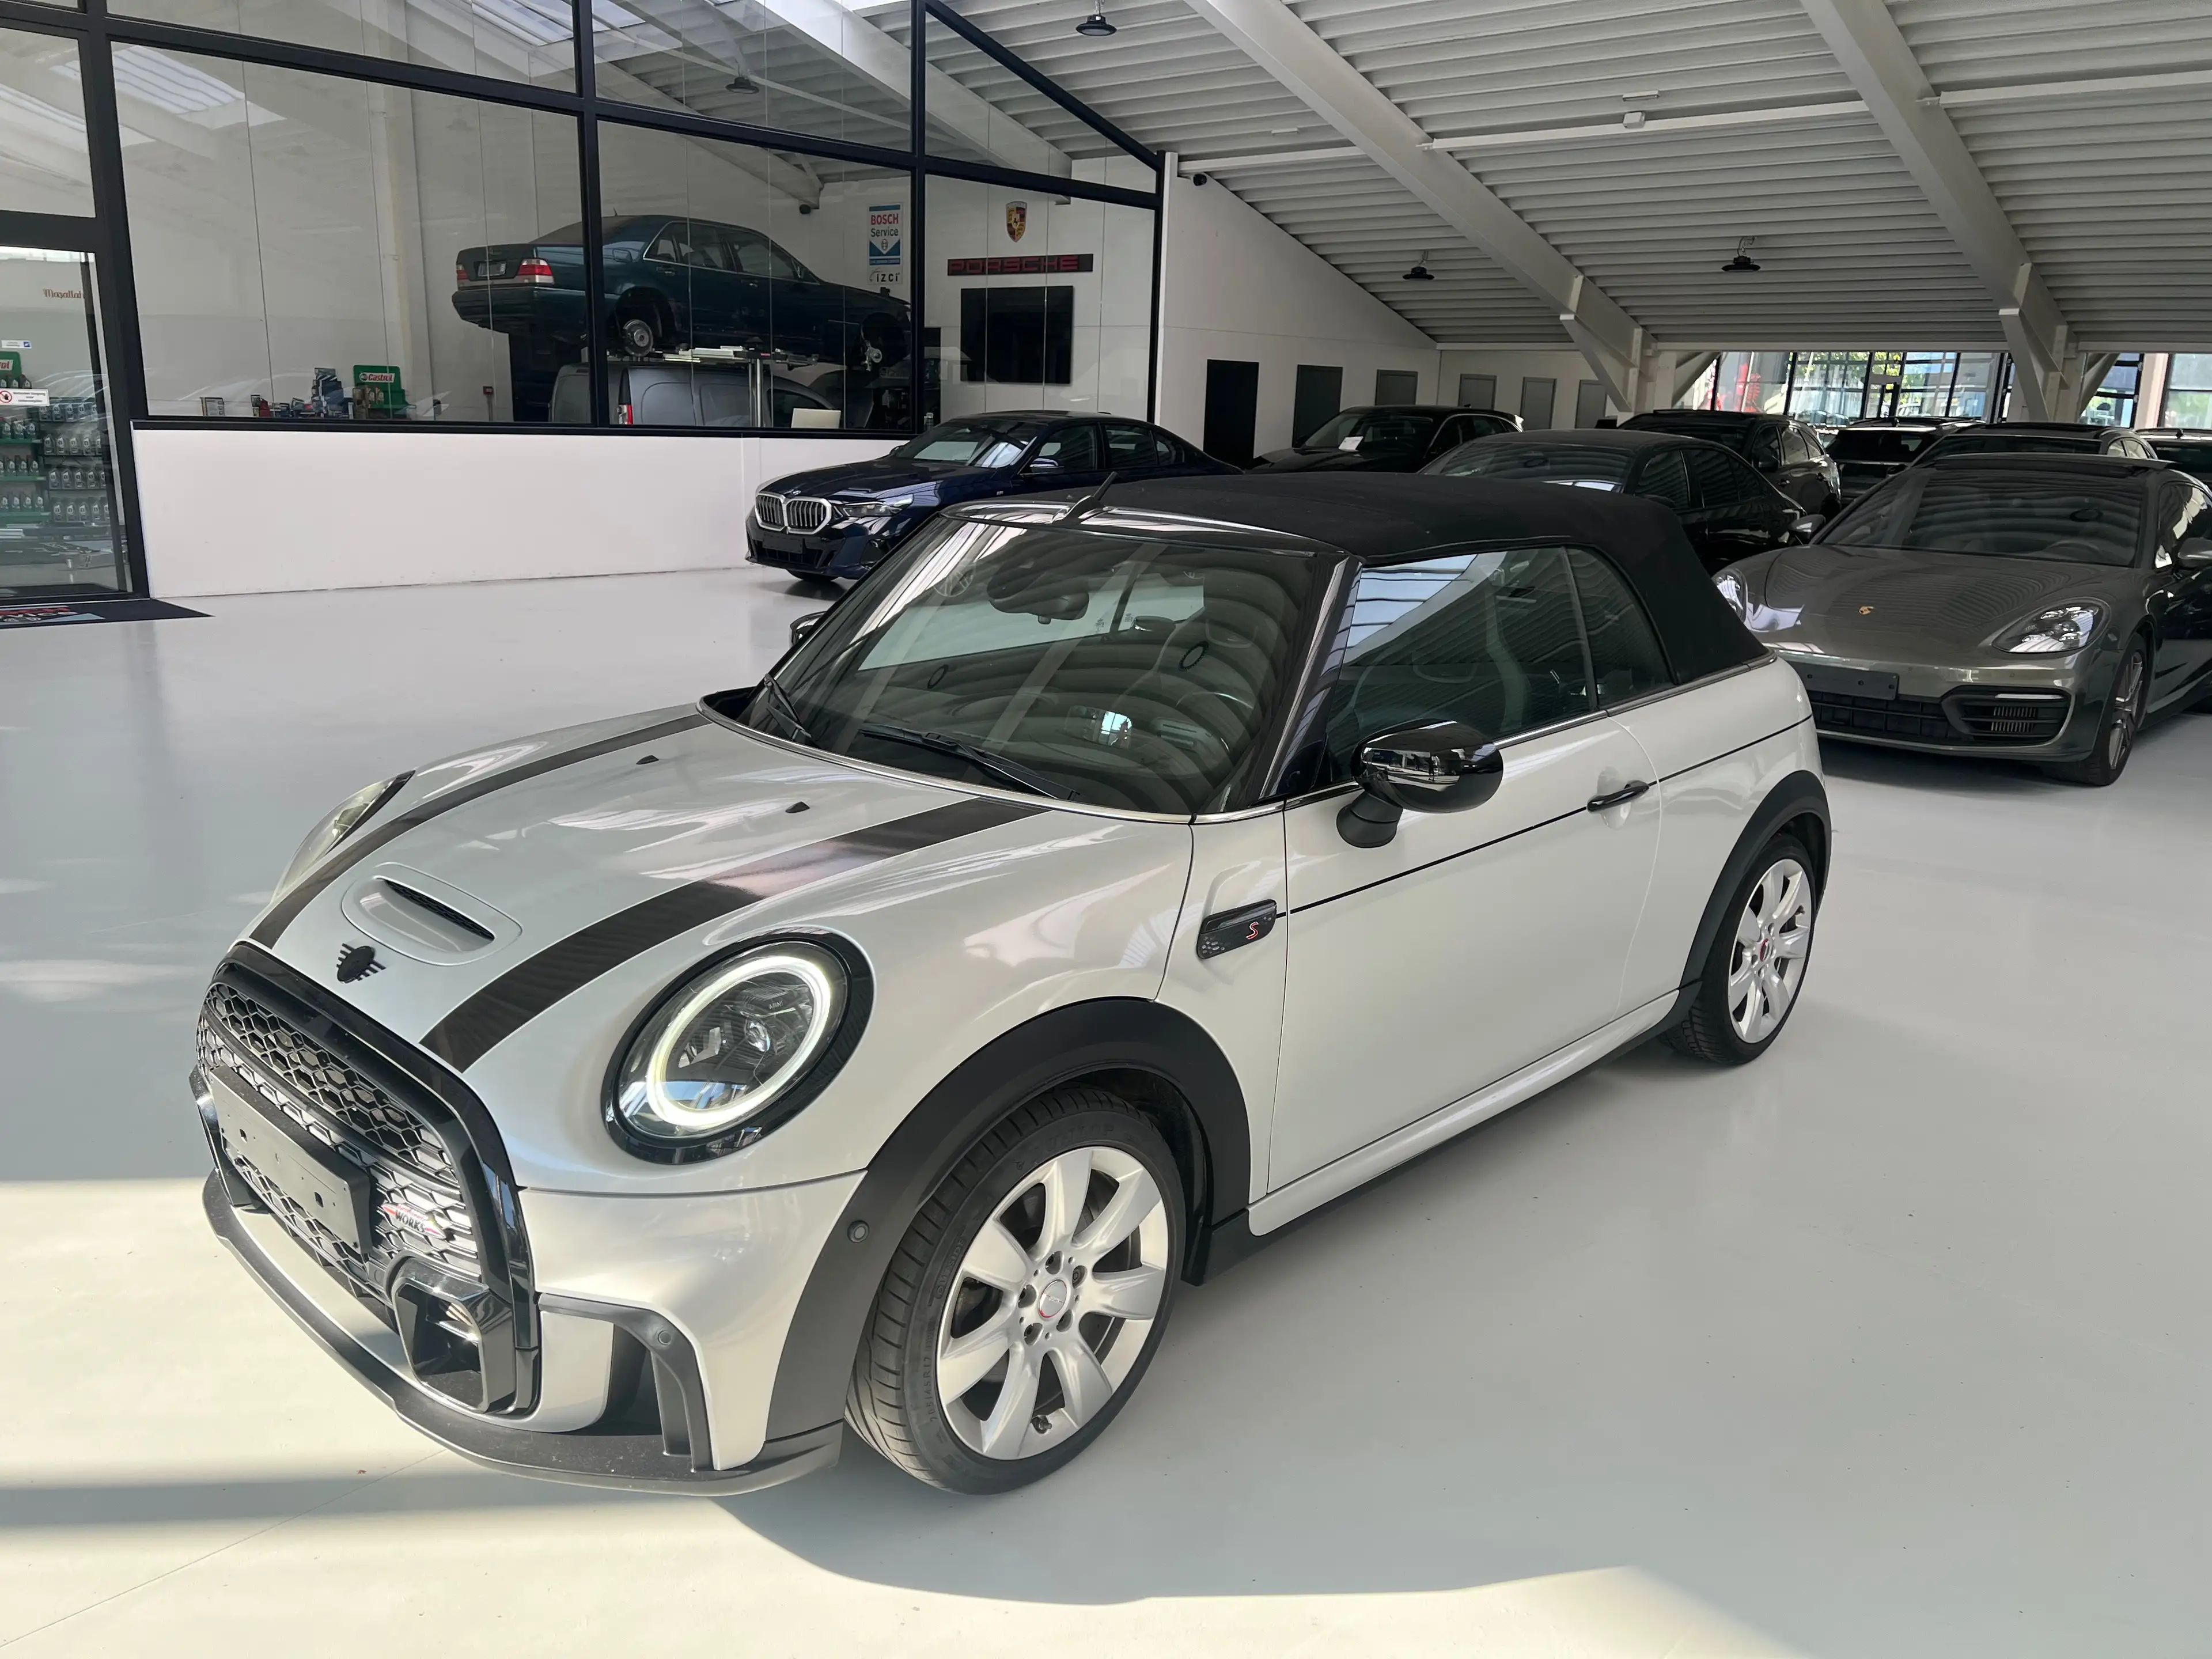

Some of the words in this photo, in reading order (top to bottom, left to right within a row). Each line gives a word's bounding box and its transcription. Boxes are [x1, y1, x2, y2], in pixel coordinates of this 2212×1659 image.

[870, 213, 899, 225] BOSCH
[870, 226, 899, 237] Service
[949, 256, 1079, 274] PORSCHE
[368, 373, 393, 381] Castrol
[1245, 921, 1259, 940] S
[395, 1210, 425, 1232] WORKS
